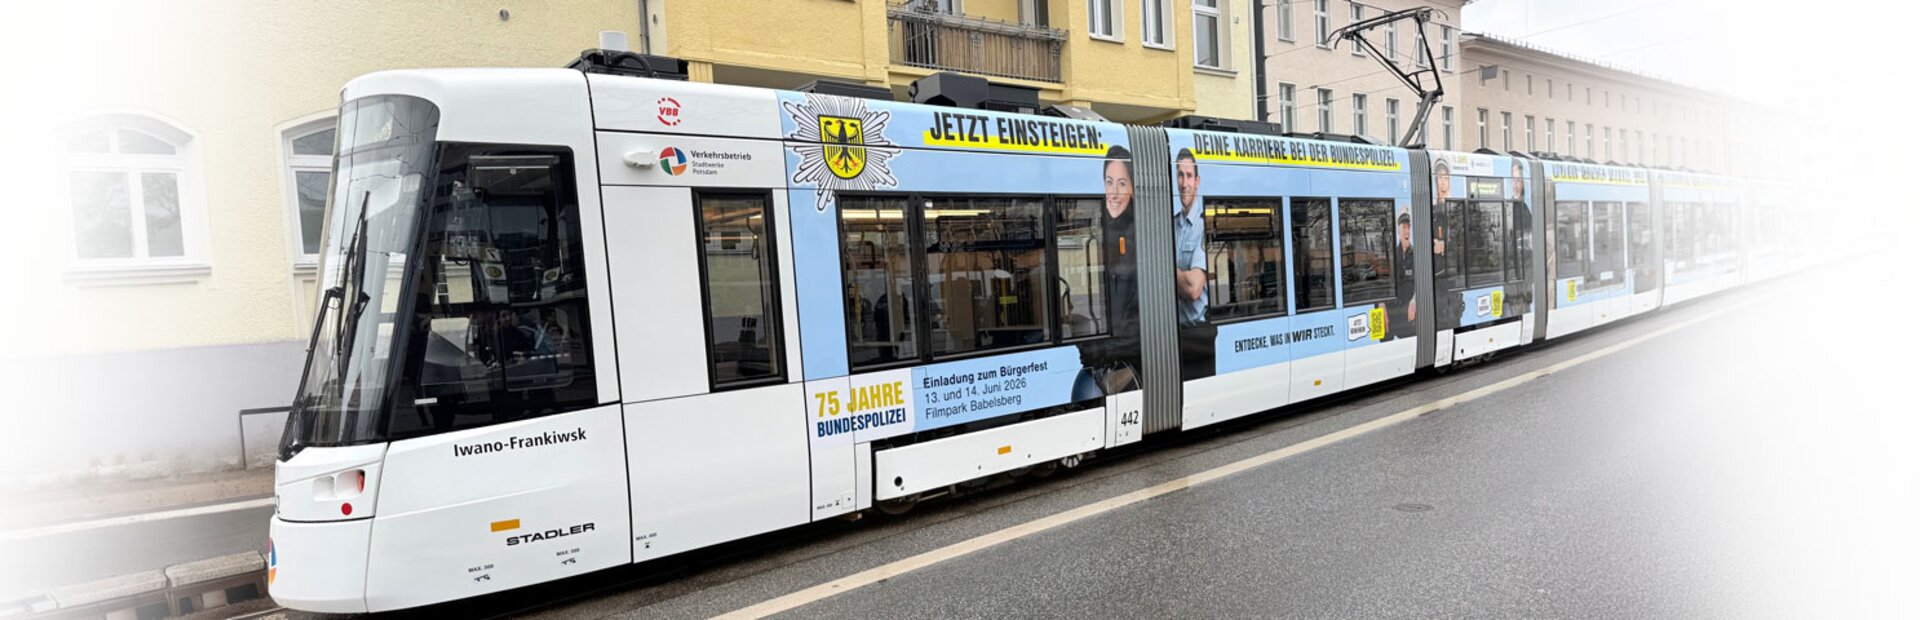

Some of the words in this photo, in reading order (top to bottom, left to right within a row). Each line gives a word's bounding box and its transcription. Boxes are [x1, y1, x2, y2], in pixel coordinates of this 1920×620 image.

[659, 107, 679, 116] VBB
[930, 111, 989, 143] JETZT
[996, 117, 1104, 150] EINSTEIGEN:
[691, 150, 752, 161] Verkehrsbetrieb
[1193, 133, 1231, 156] DEINE
[1233, 136, 1288, 160] KARRIERE
[1289, 141, 1307, 161] BEI
[1308, 143, 1329, 163] DER
[1330, 145, 1397, 168] BUNDESPOLIZEI.
[692, 161, 725, 169] Stadtwerke
[692, 168, 718, 176] Potsdam
[1270, 333, 1283, 347] WAS
[1284, 332, 1291, 344] IN
[1292, 328, 1312, 343] WIR
[1313, 325, 1335, 339] STECKT.
[923, 374, 975, 389] Einladung
[977, 369, 997, 381] zum
[1000, 361, 1048, 377] Bürgerfest
[815, 391, 840, 418] 75
[846, 381, 904, 413] JAHRE
[925, 392, 940, 404] 13.
[943, 388, 962, 402] und
[965, 386, 980, 397] 14.
[982, 382, 1001, 395] Juni
[1003, 378, 1027, 391] 2026
[925, 403, 968, 420] Filmpark
[970, 394, 1022, 412] Babelsberg
[1121, 410, 1139, 426] 442
[817, 407, 906, 438] BUNDESPOLIZEI
[454, 427, 587, 457] Iwano-Frankiwsk
[506, 522, 595, 546] STADLER
